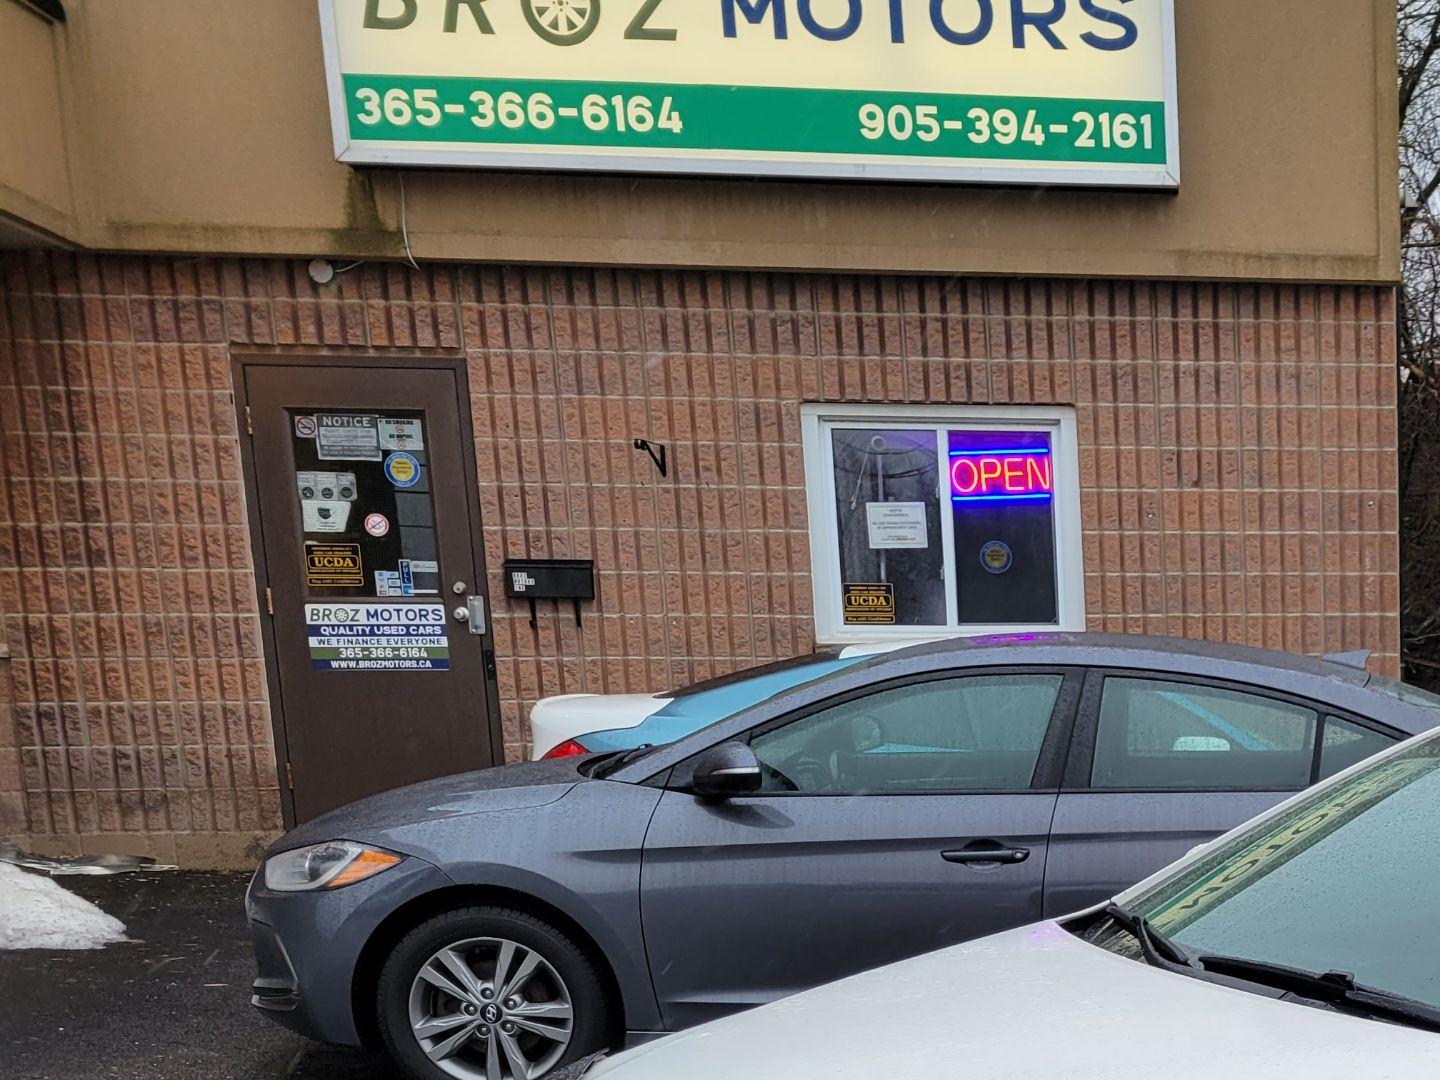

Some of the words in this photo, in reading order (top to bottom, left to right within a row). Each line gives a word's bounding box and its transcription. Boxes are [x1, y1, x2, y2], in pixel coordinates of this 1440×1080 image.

[721, 0, 1138, 52] MOTORS
[354, 87, 683, 134] 365-366-6164
[858, 103, 1153, 150] 905-394-2161
[322, 416, 371, 427] NOTICE
[951, 457, 1050, 493] OPEN
[314, 557, 354, 567] UCDA
[850, 596, 887, 605] UCDA
[310, 608, 361, 623] BROZ
[366, 608, 443, 622] MOTORS
[320, 625, 371, 636] QUALITY
[374, 626, 406, 635] USED
[409, 626, 442, 635] CARS
[339, 648, 428, 658] 365-366-6164
[330, 660, 432, 669] WWW.BROZMOTORS.CA
